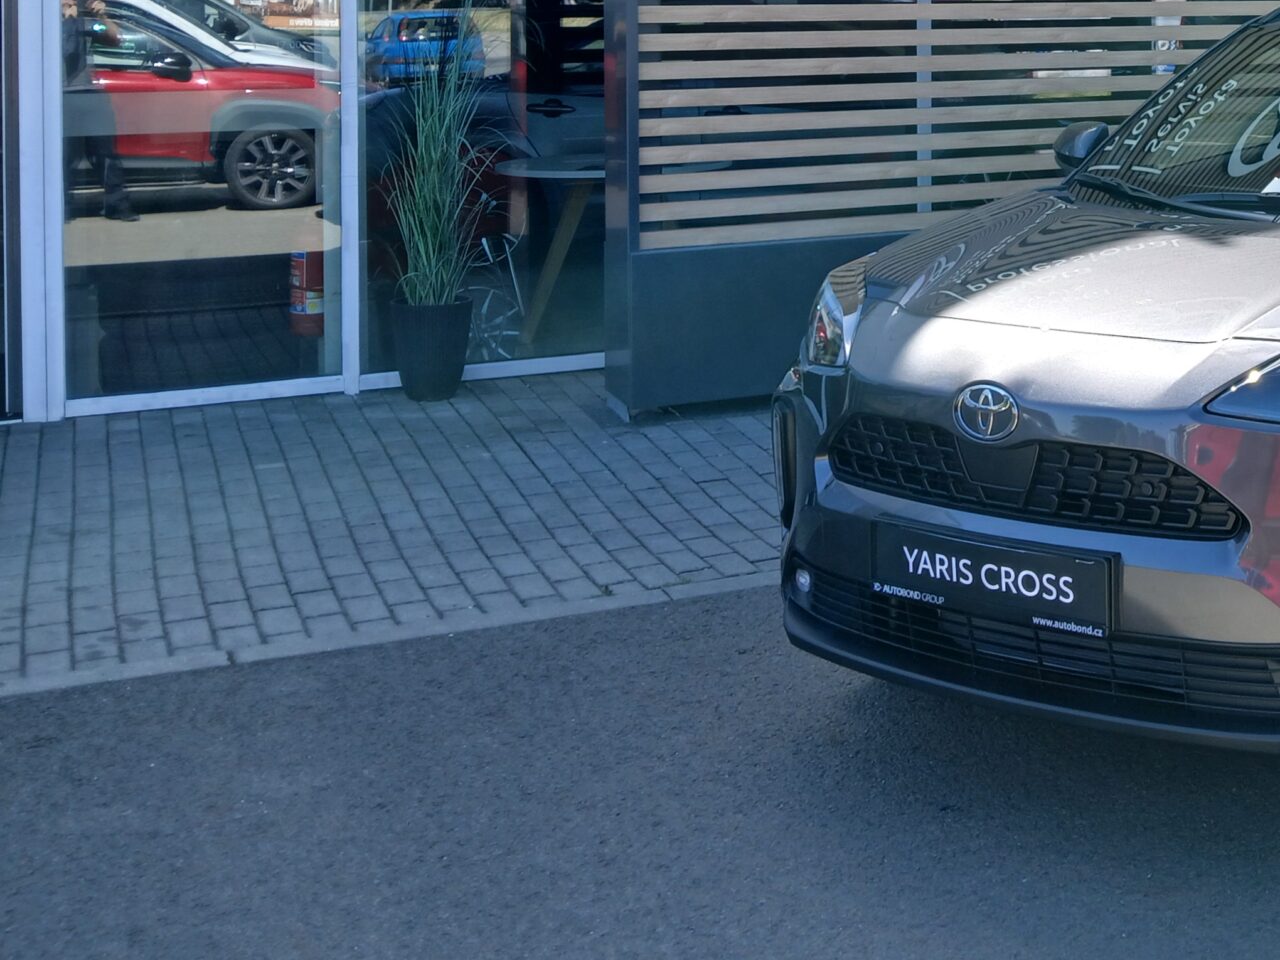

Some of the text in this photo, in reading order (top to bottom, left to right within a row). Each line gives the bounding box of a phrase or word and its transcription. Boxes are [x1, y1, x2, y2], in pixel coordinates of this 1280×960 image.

[902, 545, 1075, 604] YARIS CROSS
[882, 584, 945, 605] AUTOBOND GROUP
[1032, 616, 1103, 637] www.autobond.cz
